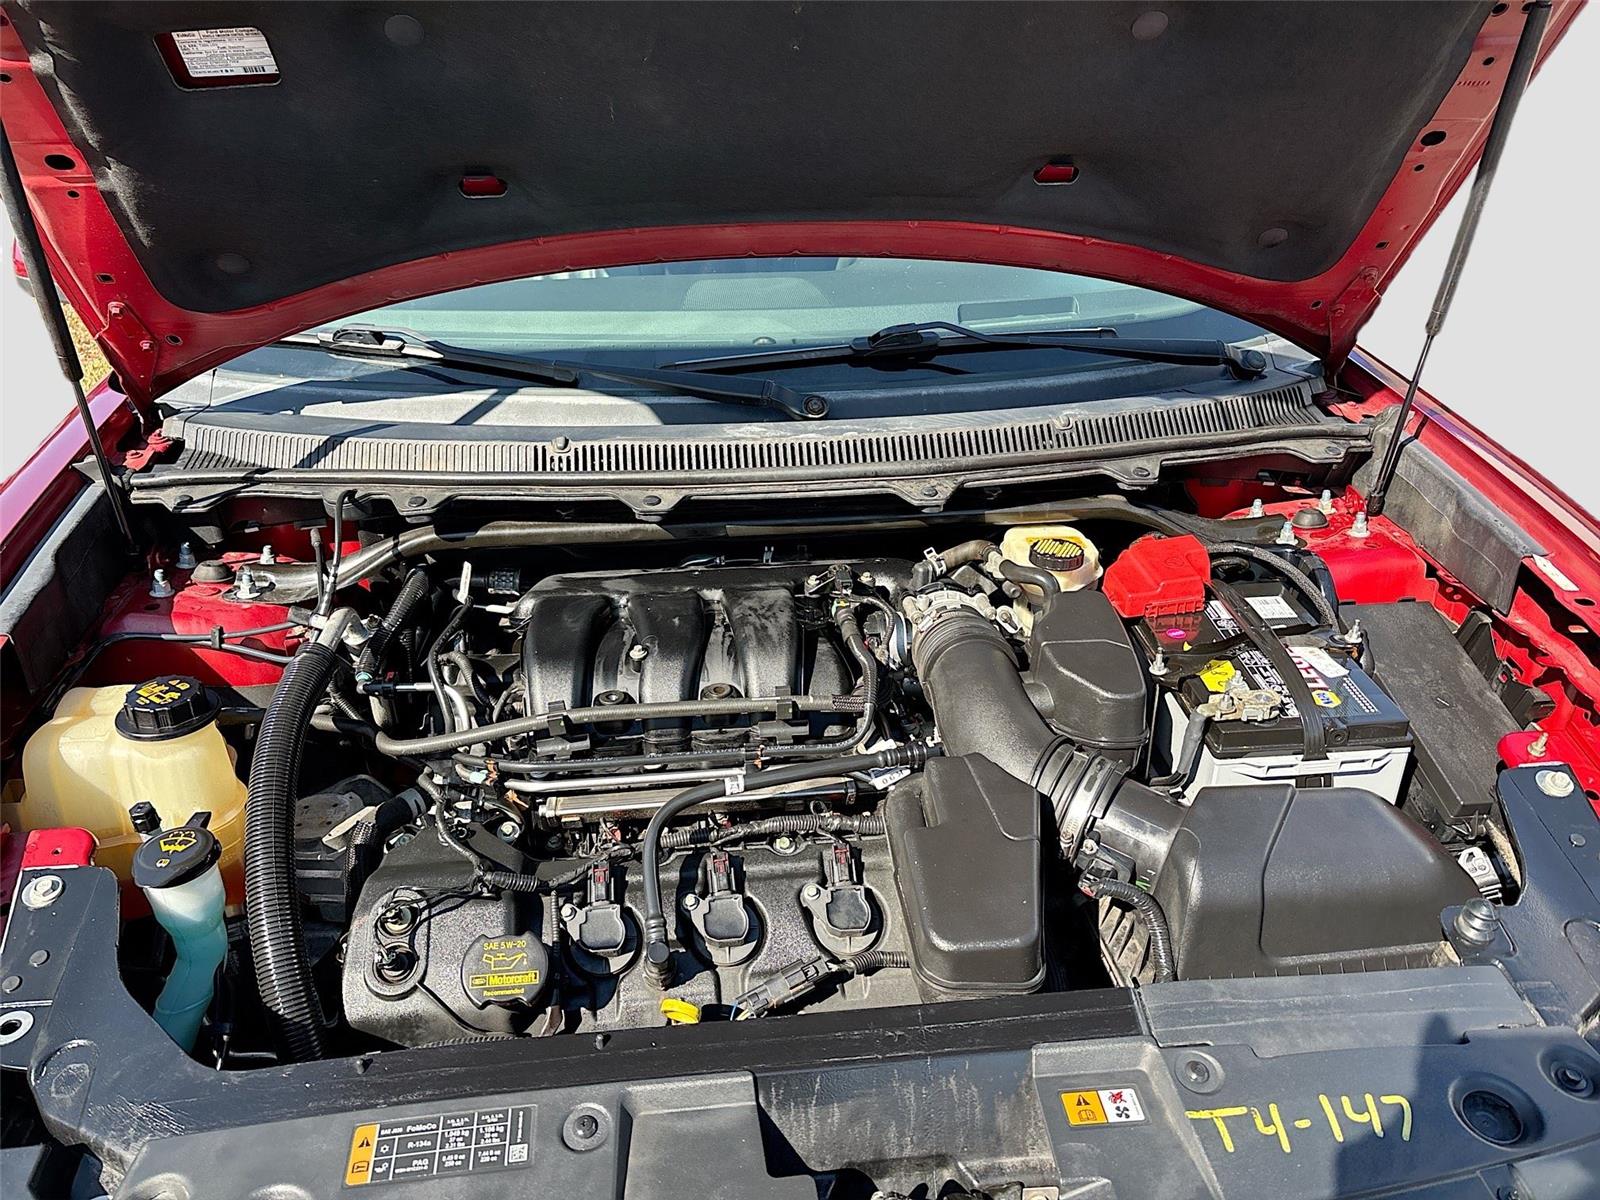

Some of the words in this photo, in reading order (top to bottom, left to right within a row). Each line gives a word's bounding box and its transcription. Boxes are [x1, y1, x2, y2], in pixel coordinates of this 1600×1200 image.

[483, 942, 499, 950] SAE
[500, 940, 527, 950] 5W-20
[490, 971, 536, 987] Motorcraft
[483, 988, 525, 997] Recommended
[1184, 1093, 1412, 1152] T4-147
[406, 1123, 437, 1132] FoMoCo
[407, 1140, 431, 1149] R-134a
[412, 1158, 429, 1167] PAG
